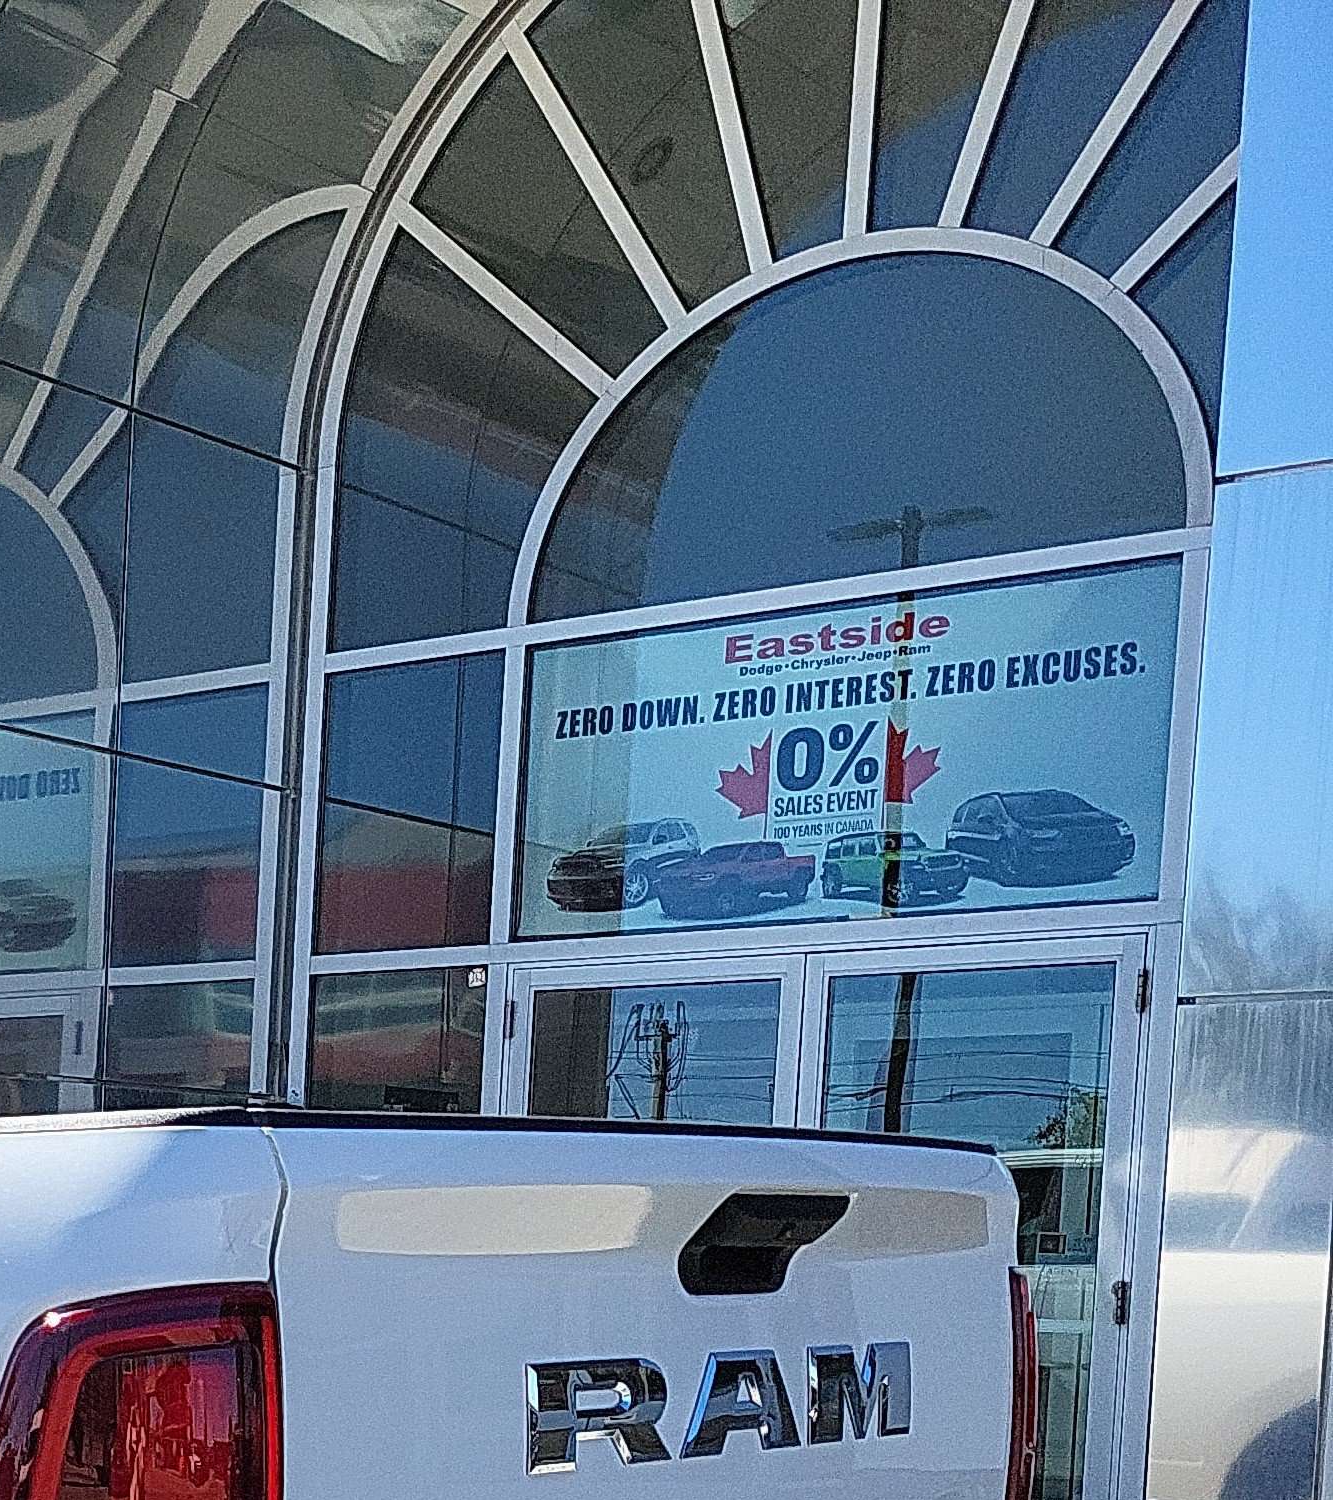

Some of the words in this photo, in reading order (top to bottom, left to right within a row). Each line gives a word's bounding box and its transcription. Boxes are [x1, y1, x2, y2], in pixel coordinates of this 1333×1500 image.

[725, 612, 950, 664] Eastside
[555, 705, 614, 740] ZERO
[621, 695, 705, 733] DOWN.
[712, 684, 776, 722] ZERO
[784, 668, 916, 715] INTEREST.
[924, 658, 995, 698] ZERO
[1005, 641, 1146, 689] EXCUSES.
[776, 720, 879, 792] 0%
[773, 793, 824, 817] SALES
[827, 788, 879, 813] EVENT
[773, 826, 790, 840] 100
[792, 823, 823, 838] YEARS
[824, 821, 834, 834] IN
[835, 818, 874, 834] CANADA
[526, 1340, 912, 1476] RAM
